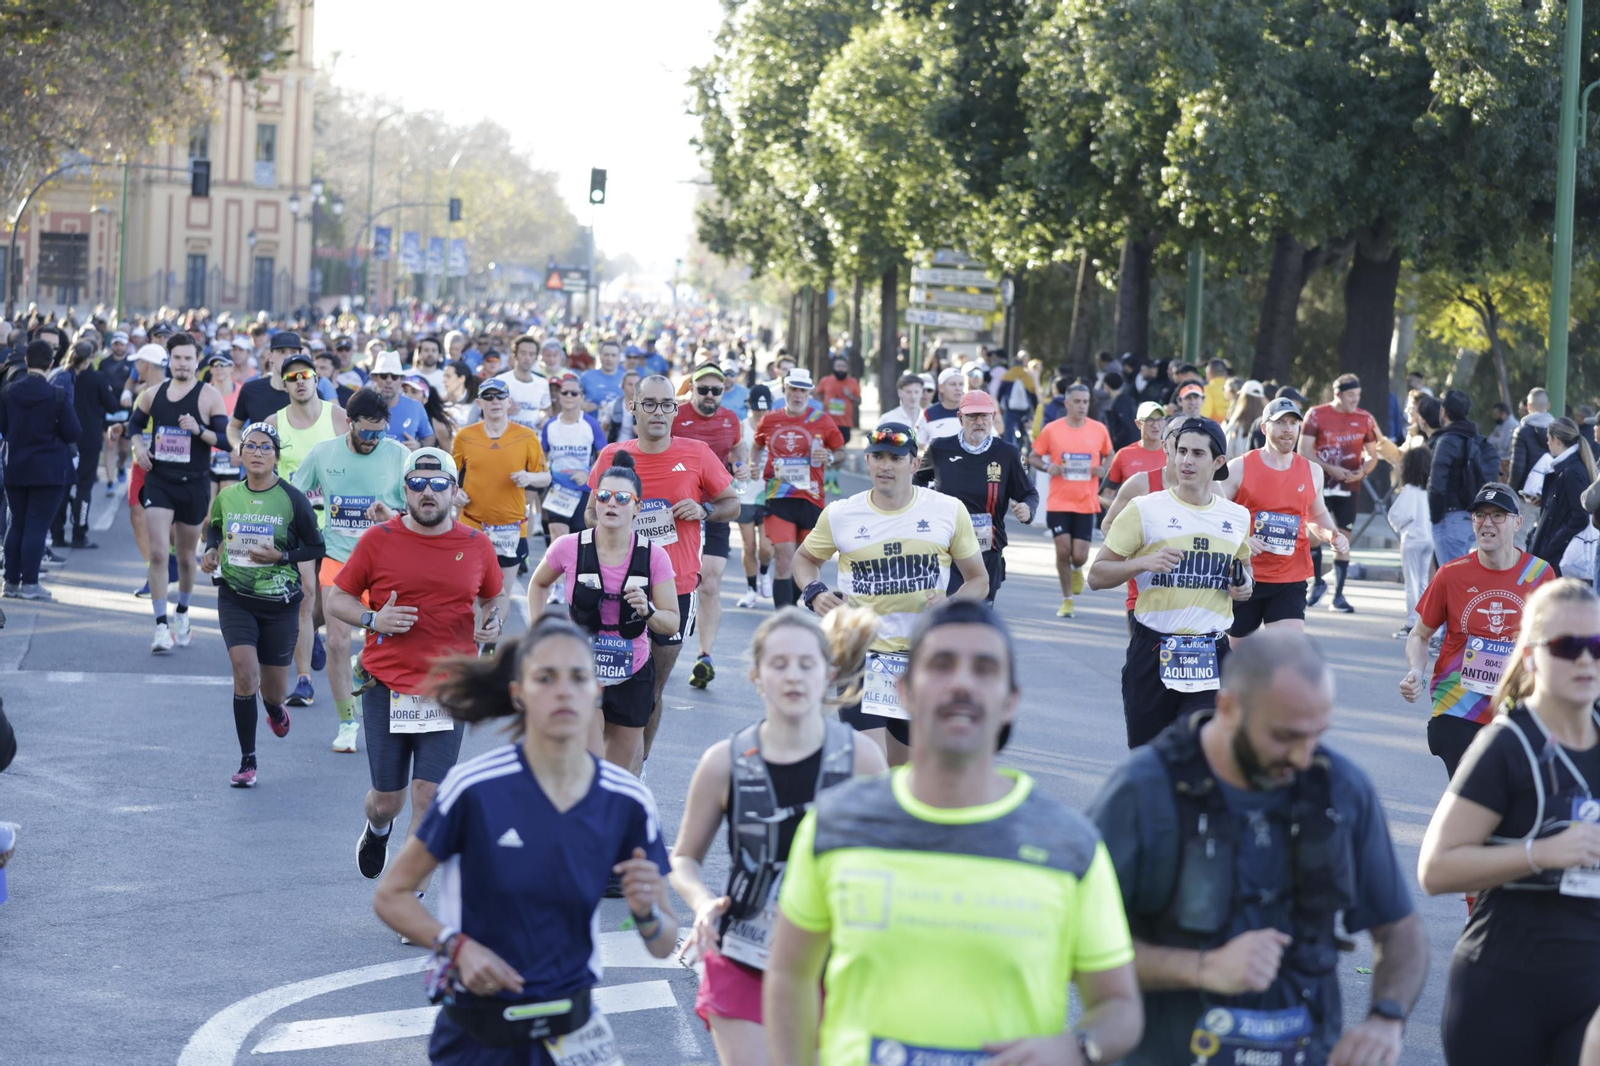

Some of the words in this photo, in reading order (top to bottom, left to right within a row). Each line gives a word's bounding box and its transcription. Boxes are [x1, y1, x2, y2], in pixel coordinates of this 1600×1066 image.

[641, 500, 665, 509] URICH
[331, 518, 350, 527] NANO
[351, 520, 375, 528] OJEDA
[637, 516, 656, 525] 11759
[1270, 515, 1295, 523] ZURICH
[241, 525, 268, 533] ZURICH
[1193, 536, 1209, 551] 59
[1266, 536, 1296, 547] SHEEHAN
[883, 541, 902, 556] 59
[1151, 574, 1175, 588] SAN
[851, 580, 872, 596] SAN
[1180, 640, 1210, 649] ZURICH
[1486, 643, 1515, 654] ZURIC
[1179, 656, 1199, 665] 13464
[1484, 659, 1503, 669] 8042
[594, 664, 627, 678] ORGIA
[1164, 666, 1214, 679] AQUILINO
[1461, 667, 1502, 683] ANTONI
[863, 691, 880, 702] ALE
[882, 694, 900, 705] AQU
[390, 710, 420, 720] JORGE
[424, 709, 452, 719] JAIM
